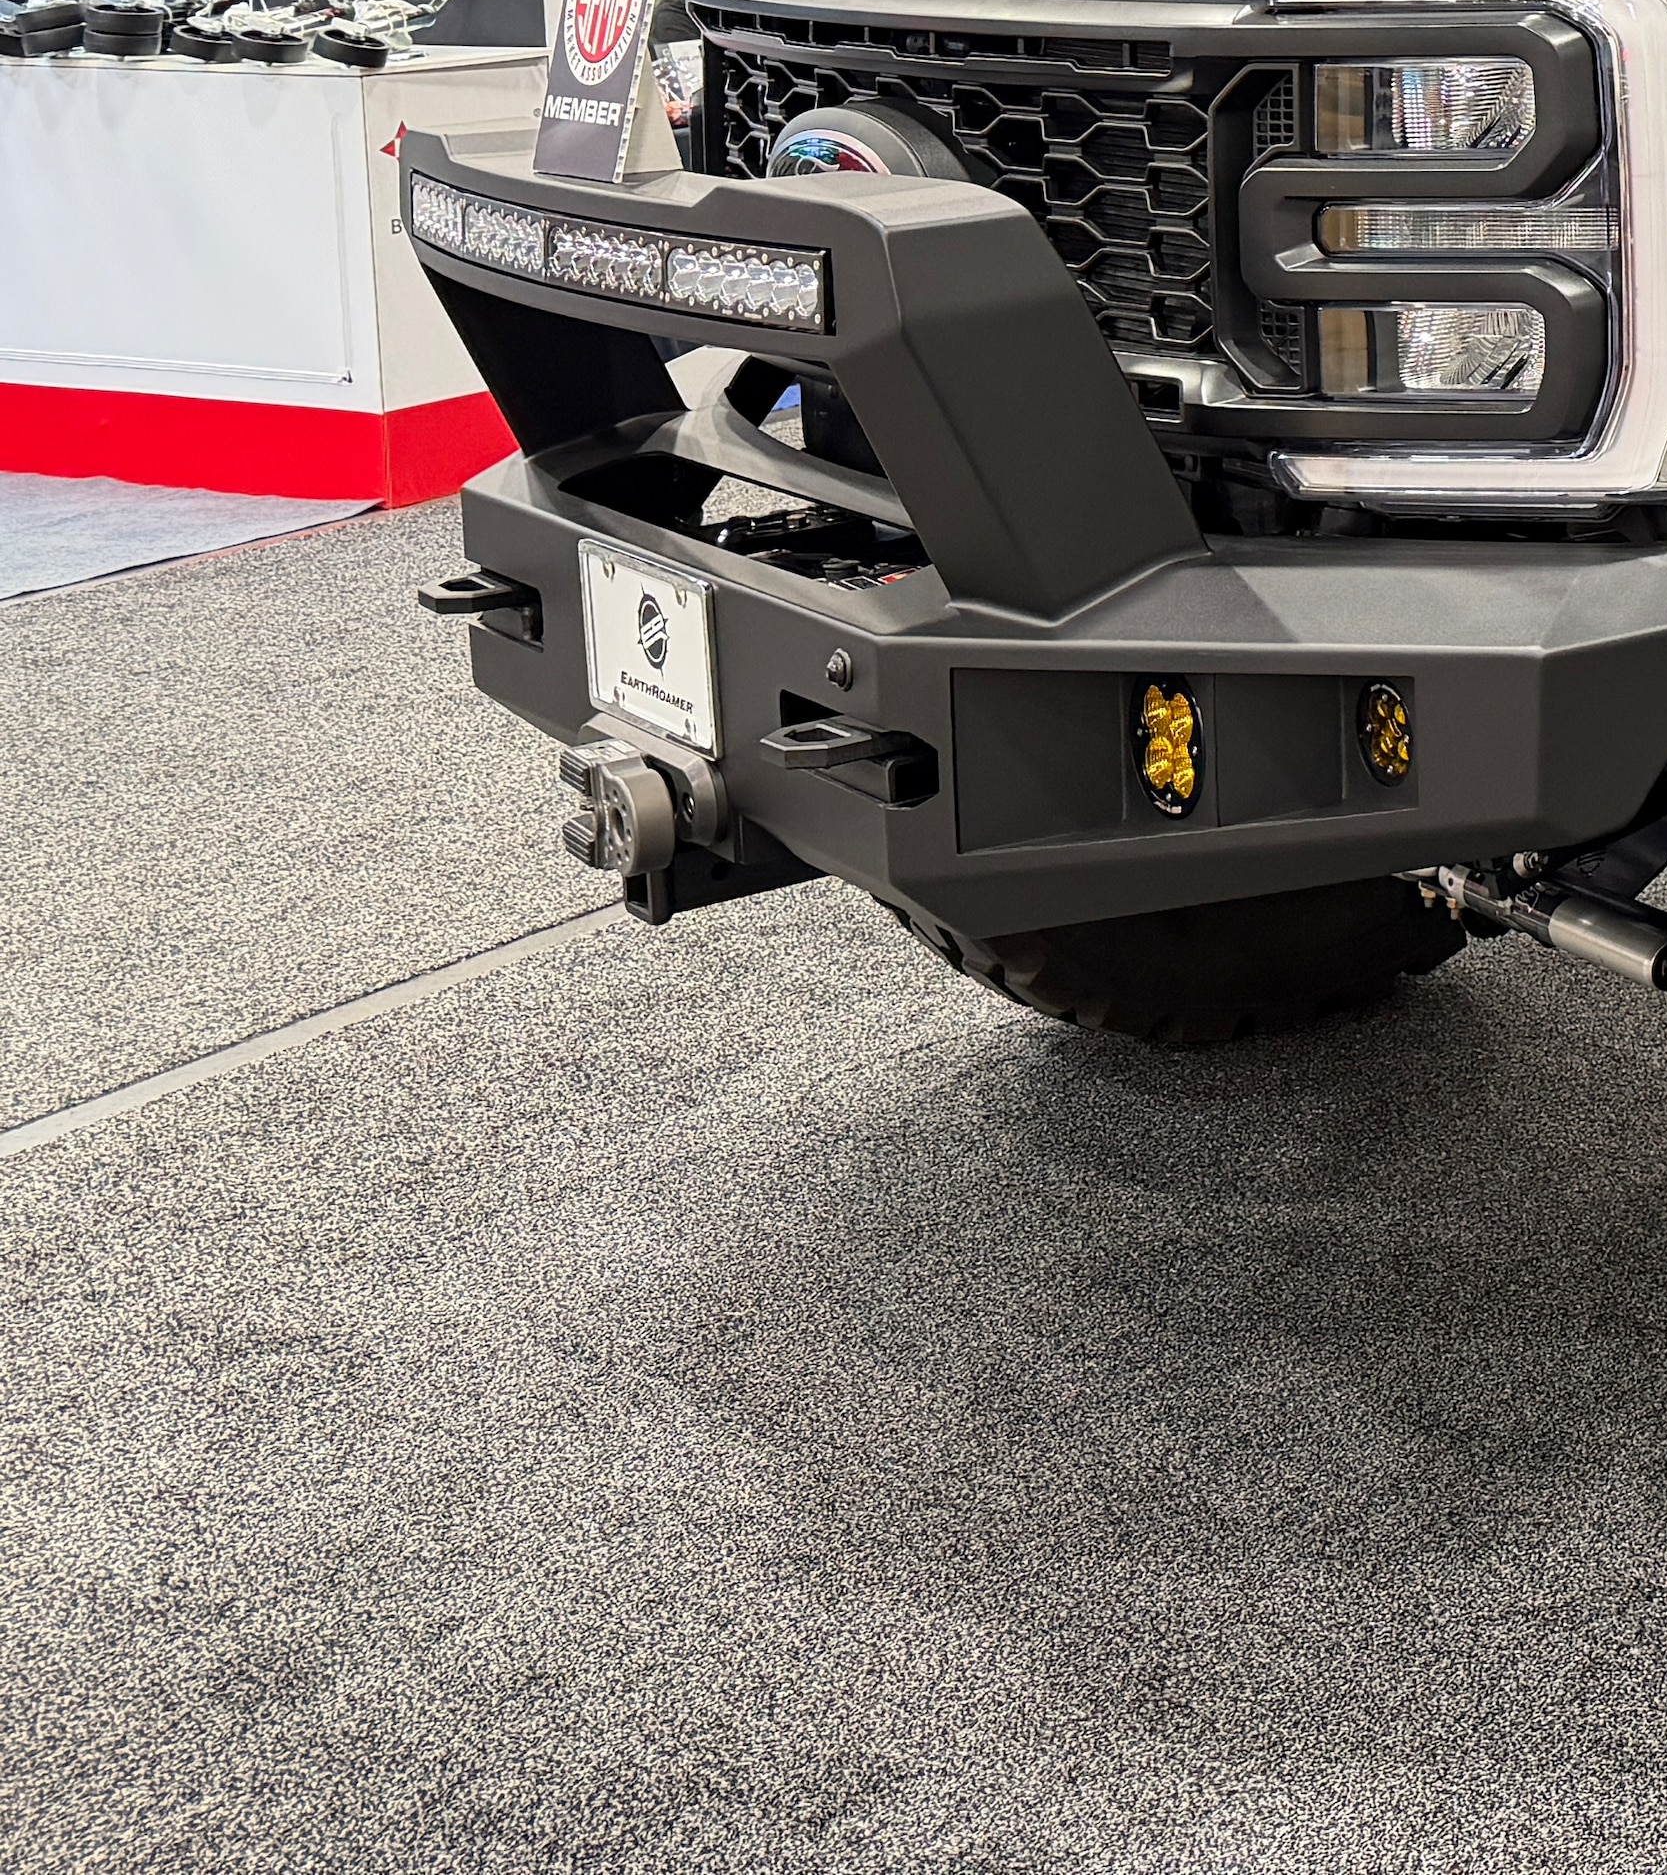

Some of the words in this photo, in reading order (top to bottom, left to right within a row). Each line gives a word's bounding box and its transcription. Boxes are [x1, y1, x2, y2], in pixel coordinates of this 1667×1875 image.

[565, 8, 582, 73] MARKET
[580, 12, 636, 79] ASSOCIATION
[544, 94, 623, 126] MEMBER
[620, 670, 694, 714] EARTHROAMER
